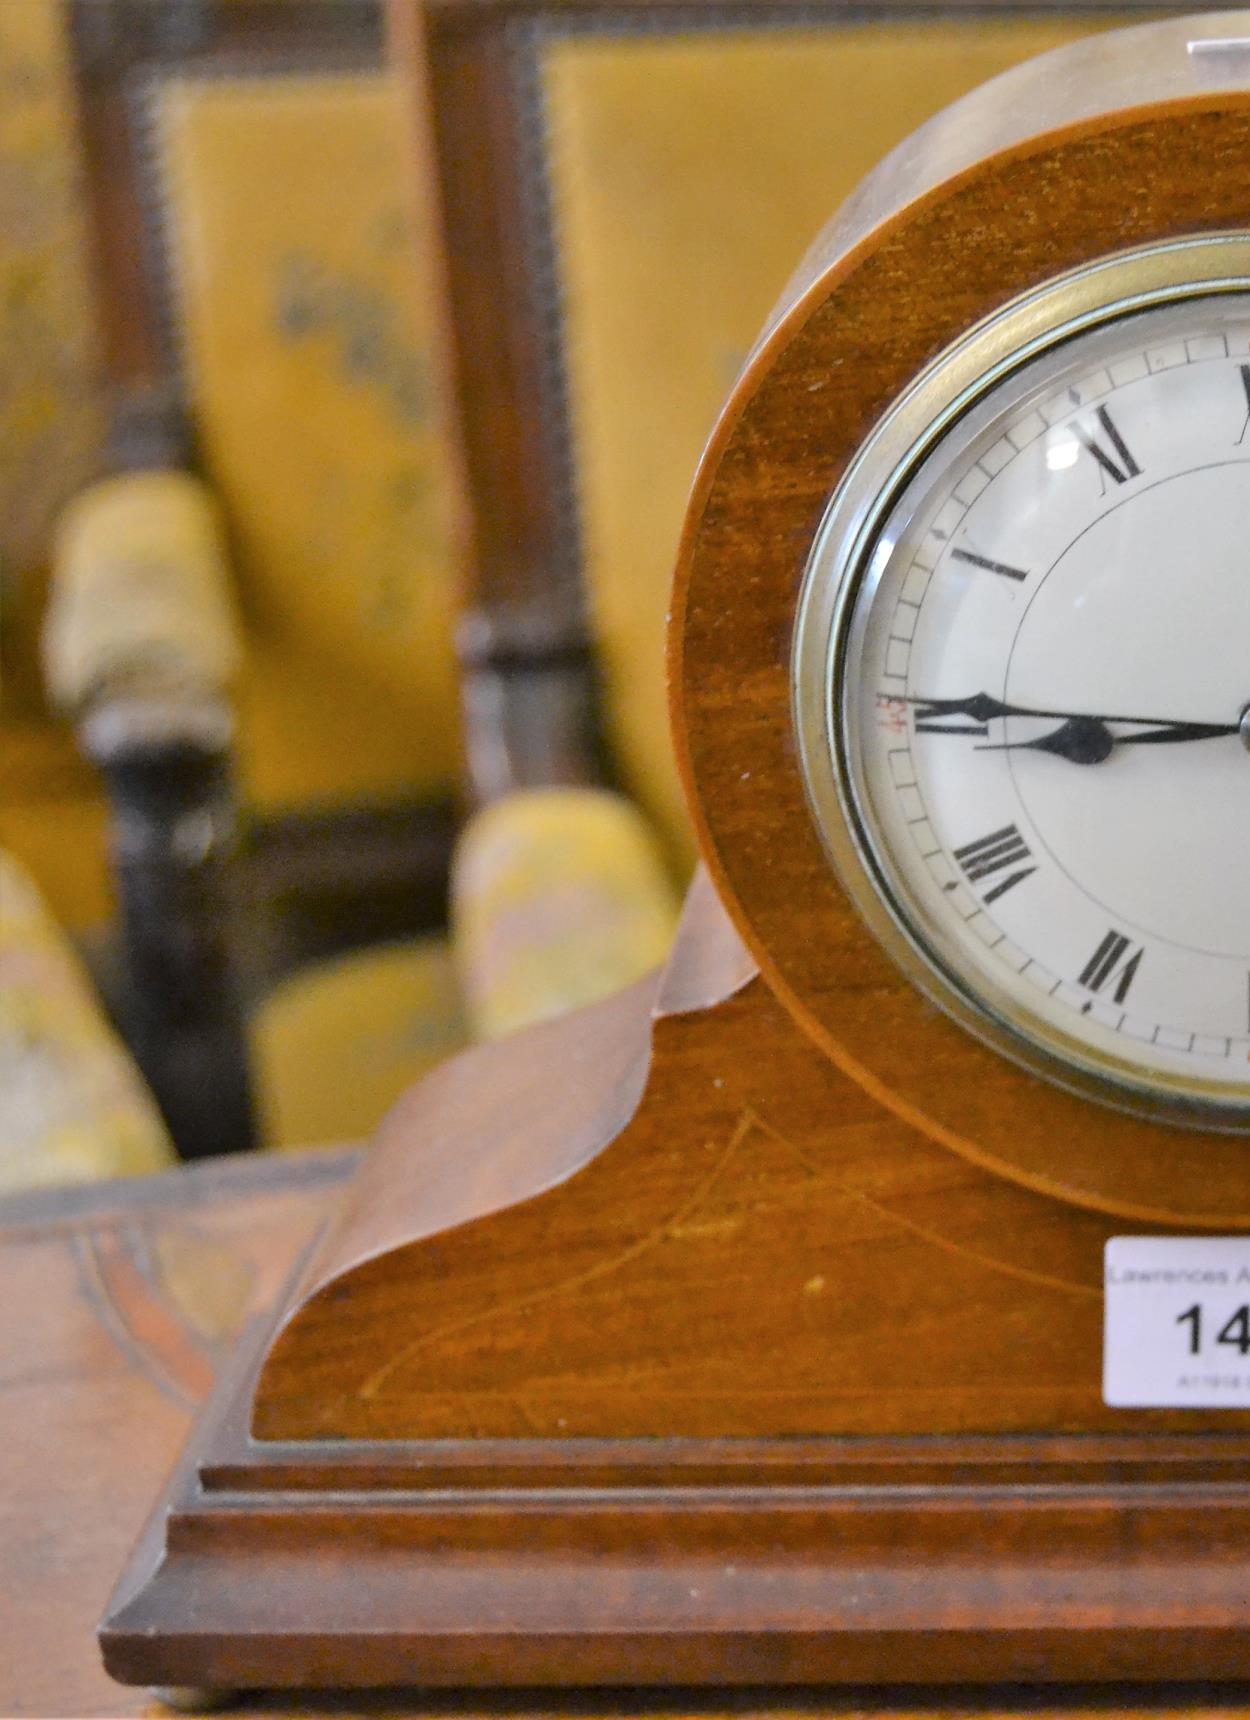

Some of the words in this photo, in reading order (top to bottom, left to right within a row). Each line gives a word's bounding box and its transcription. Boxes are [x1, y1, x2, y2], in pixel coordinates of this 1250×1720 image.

[1066, 401, 1145, 498] XI
[953, 824, 1037, 904] VIII
[1078, 929, 1145, 1005] VII
[1108, 1266, 1228, 1285] Lawrences
